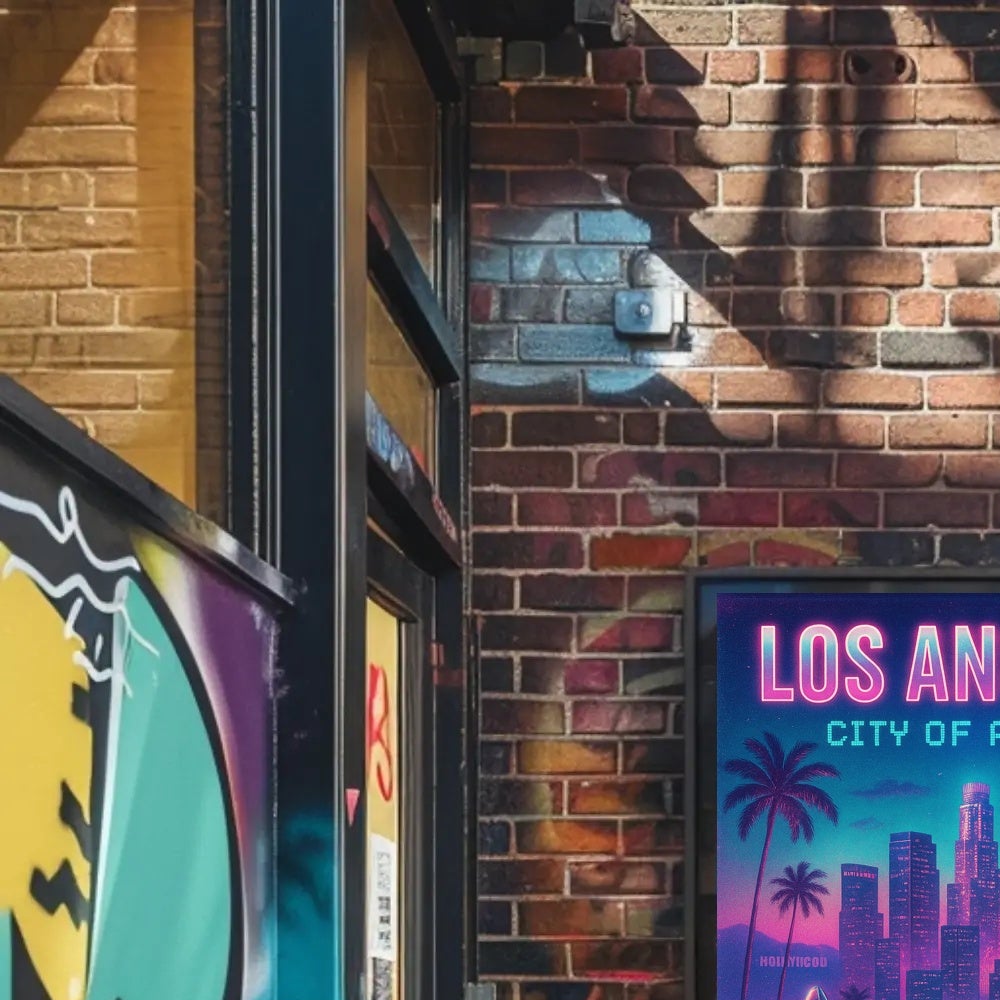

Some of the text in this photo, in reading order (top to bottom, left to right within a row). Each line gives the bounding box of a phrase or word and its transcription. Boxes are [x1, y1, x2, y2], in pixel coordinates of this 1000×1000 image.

[760, 624, 885, 703] LOS
[826, 720, 909, 747] CITY
[925, 720, 972, 747] OF
